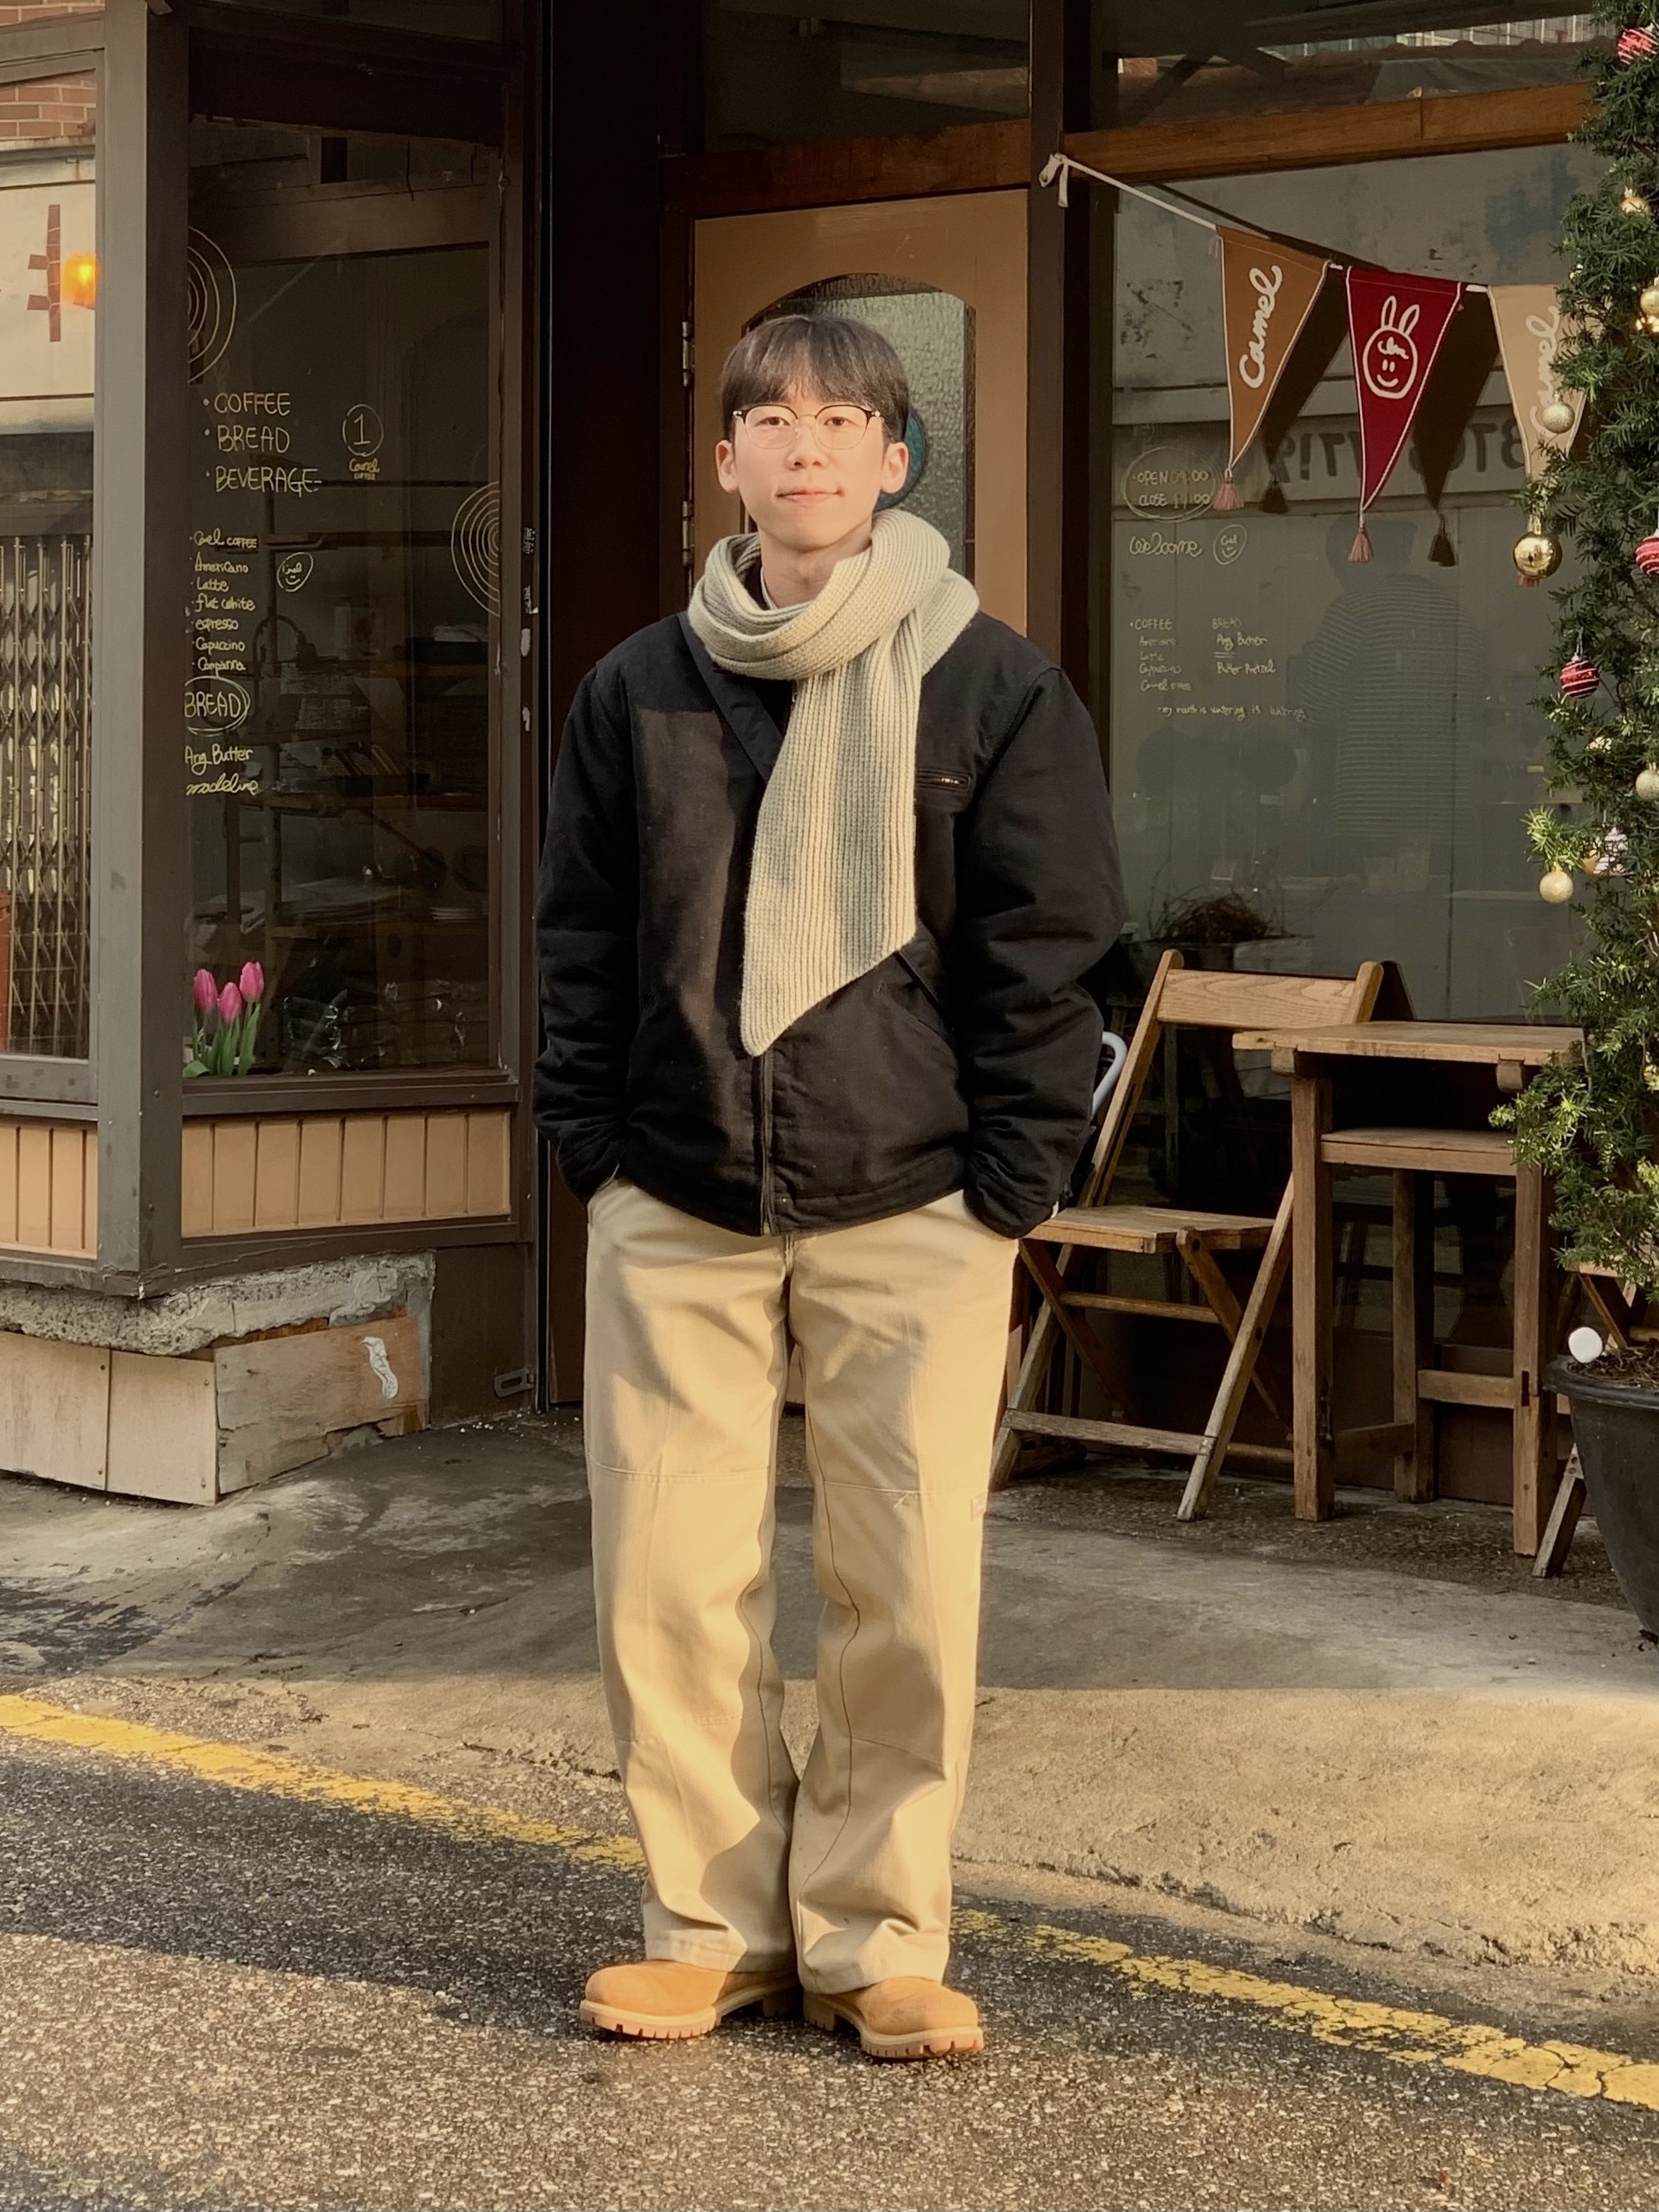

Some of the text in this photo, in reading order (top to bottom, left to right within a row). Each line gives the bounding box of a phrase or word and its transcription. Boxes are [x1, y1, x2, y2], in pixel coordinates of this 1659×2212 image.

[1238, 265, 1283, 389] Camel
[214, 392, 291, 416] COFFEE
[217, 424, 290, 453] BREAD
[354, 413, 371, 445] 1
[215, 466, 322, 498] BEVERAGE
[1137, 470, 1168, 486] OPEN
[1139, 493, 1167, 507] CLOSE
[196, 576, 230, 592] Latte
[195, 592, 219, 612] flat
[1135, 619, 1173, 630] COFFEE
[185, 691, 241, 717] BREAD
[212, 743, 253, 765] Butter
